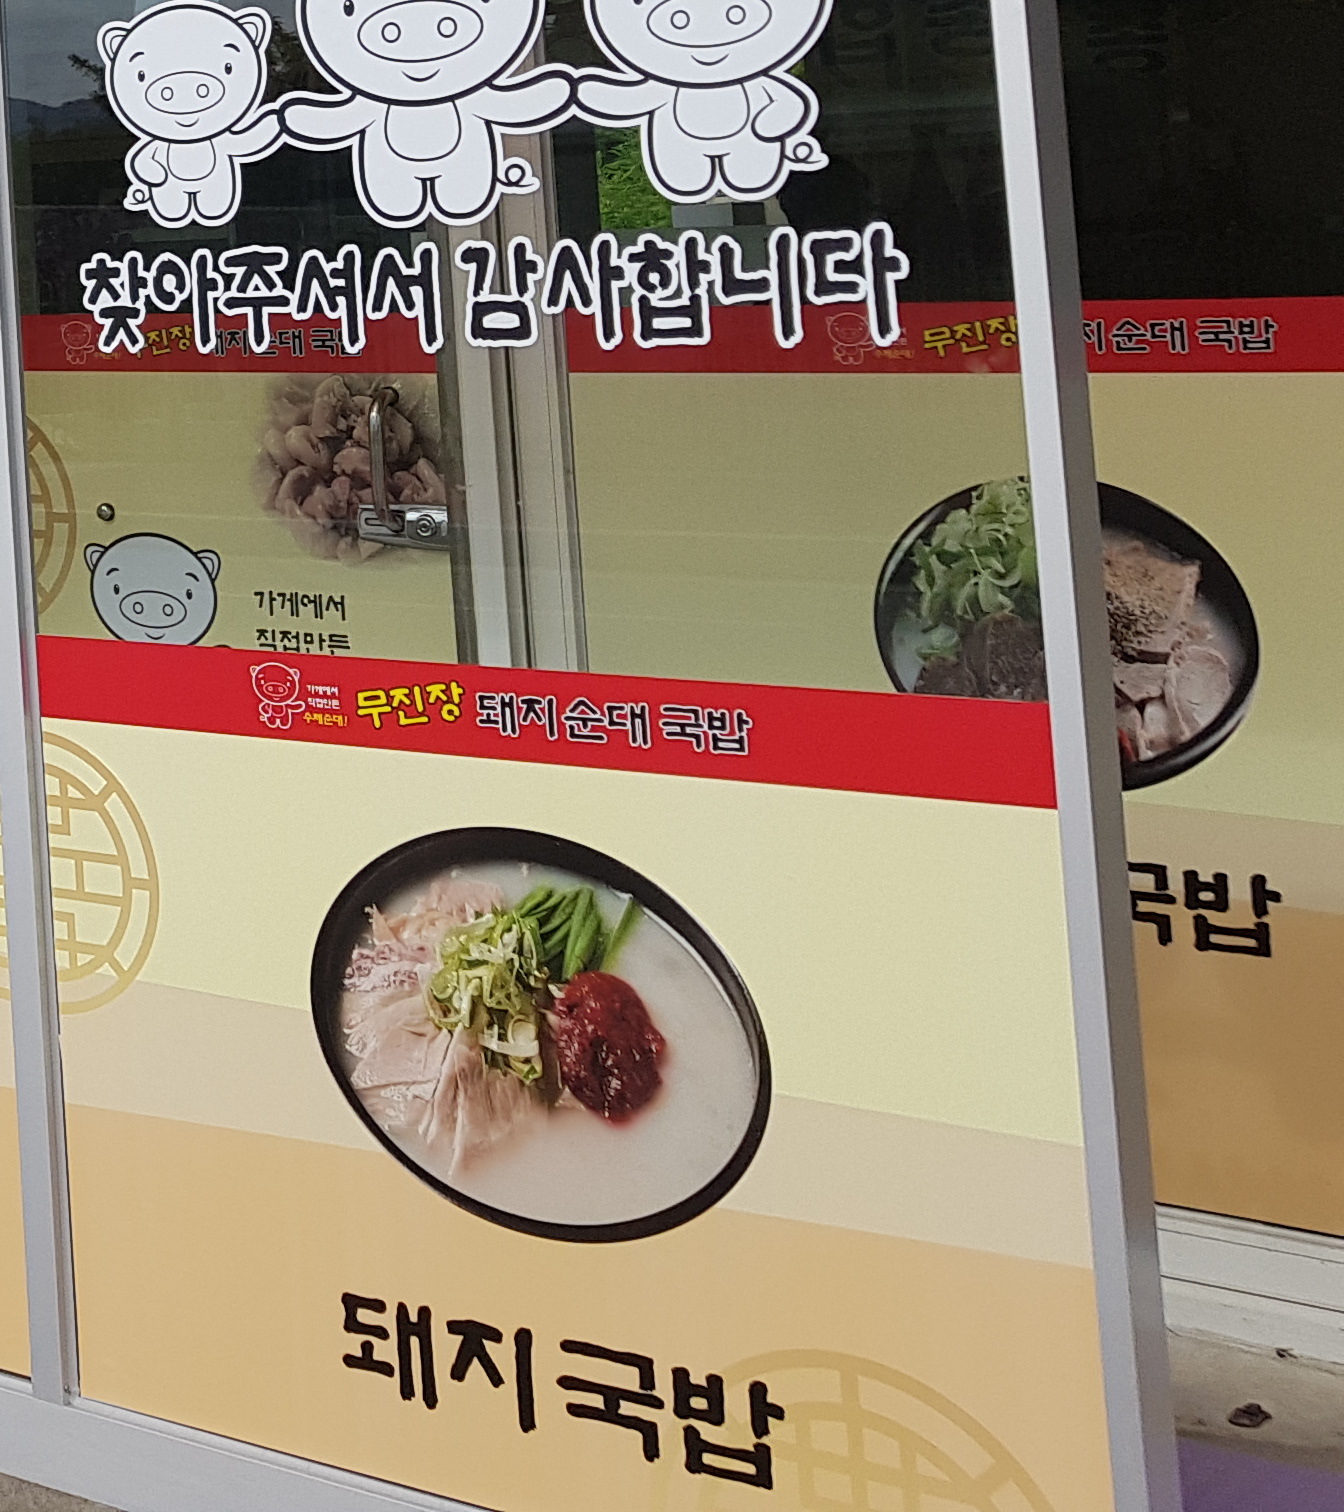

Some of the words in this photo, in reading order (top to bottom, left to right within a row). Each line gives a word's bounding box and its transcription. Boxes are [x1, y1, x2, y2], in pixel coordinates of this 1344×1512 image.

[81, 243, 443, 355] 찾아주셔서
[456, 220, 910, 350] 감사합니다
[137, 324, 193, 358] 진장
[923, 316, 1018, 358] 무진장
[1083, 318, 1188, 355] 지순대
[1197, 316, 1278, 354] 국밥
[253, 590, 346, 621] 가게에서
[256, 629, 350, 655] 직접만든
[355, 680, 465, 730] 무진장
[475, 692, 651, 749] 돼지순대
[659, 704, 751, 755] 국밥
[341, 1292, 785, 1490] 돼지국밥
